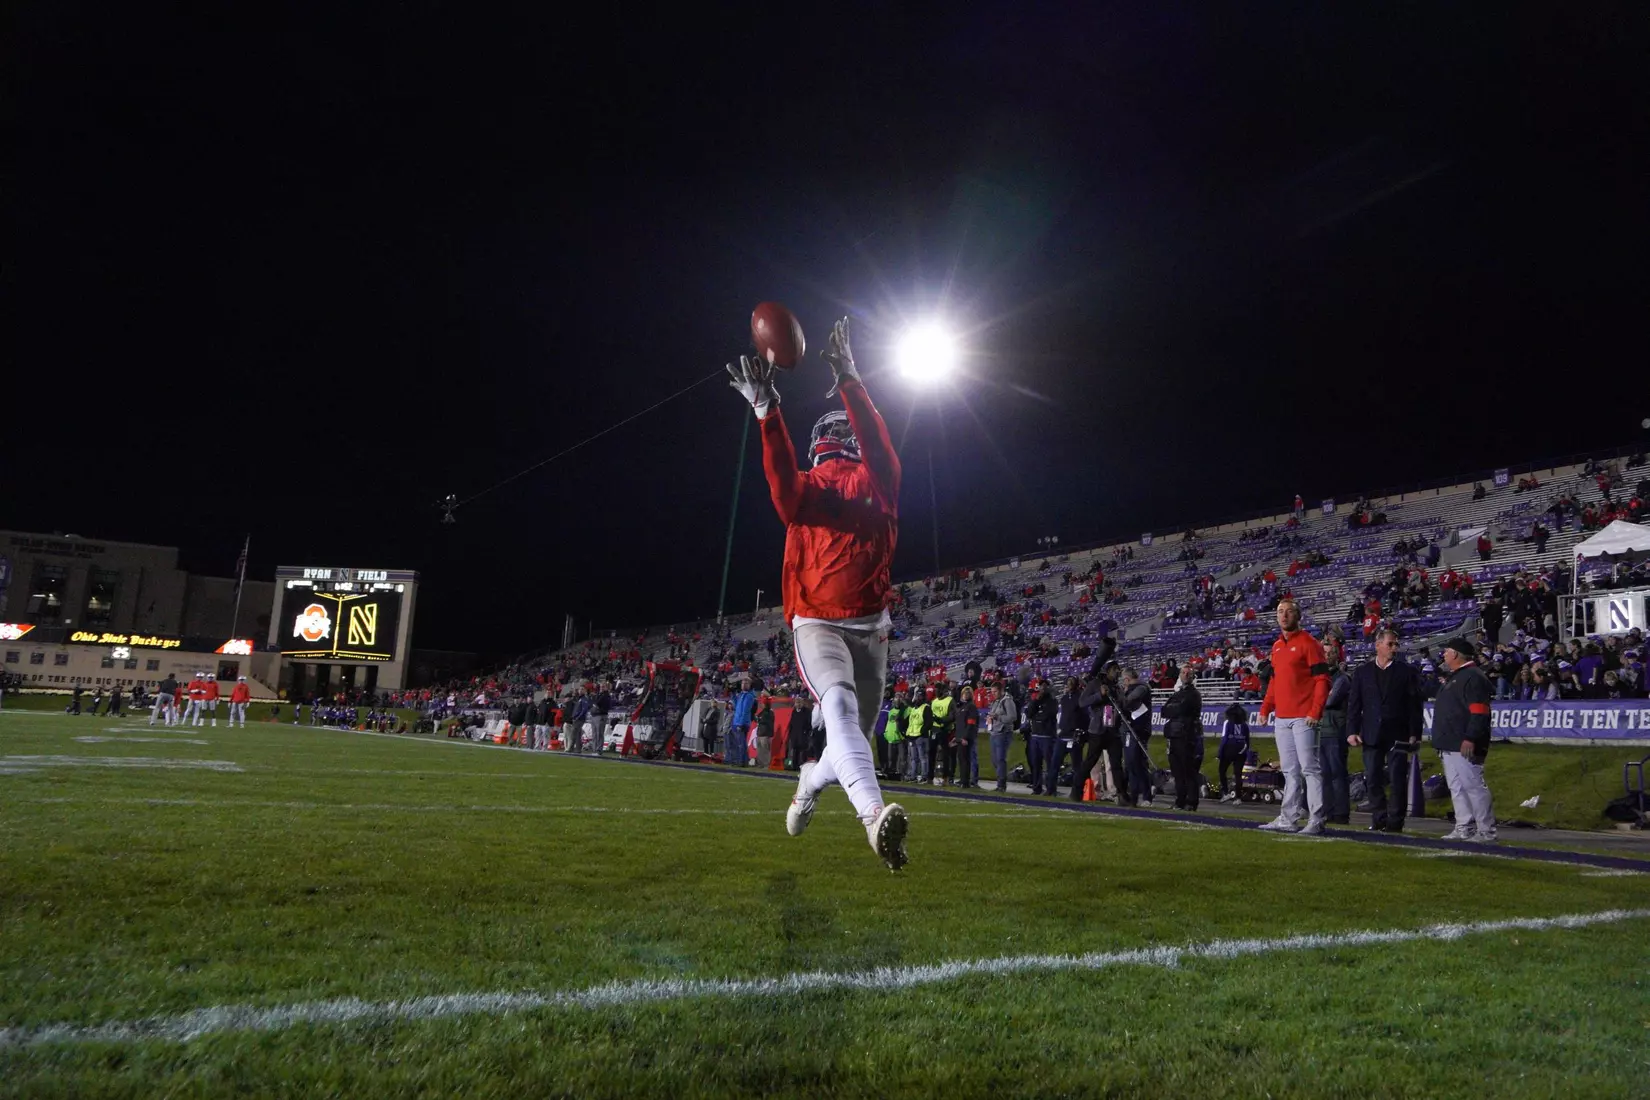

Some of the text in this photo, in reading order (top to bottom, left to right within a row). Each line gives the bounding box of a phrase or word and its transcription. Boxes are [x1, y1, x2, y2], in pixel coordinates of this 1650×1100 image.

[303, 568, 331, 579] RYAN
[357, 570, 387, 581] FIELD
[1608, 599, 1633, 631] N
[347, 603, 378, 645] N
[71, 631, 181, 649] Ohio State Buckeyes
[112, 647, 129, 659] 25
[31, 674, 44, 682] OF
[48, 675, 67, 683] THE
[70, 676, 92, 684] 2018
[96, 677, 112, 685] BIG
[115, 678, 133, 686] TEN
[1542, 709, 1574, 729] BIG
[1579, 709, 1620, 730] TEN
[1234, 723, 1242, 735] N
